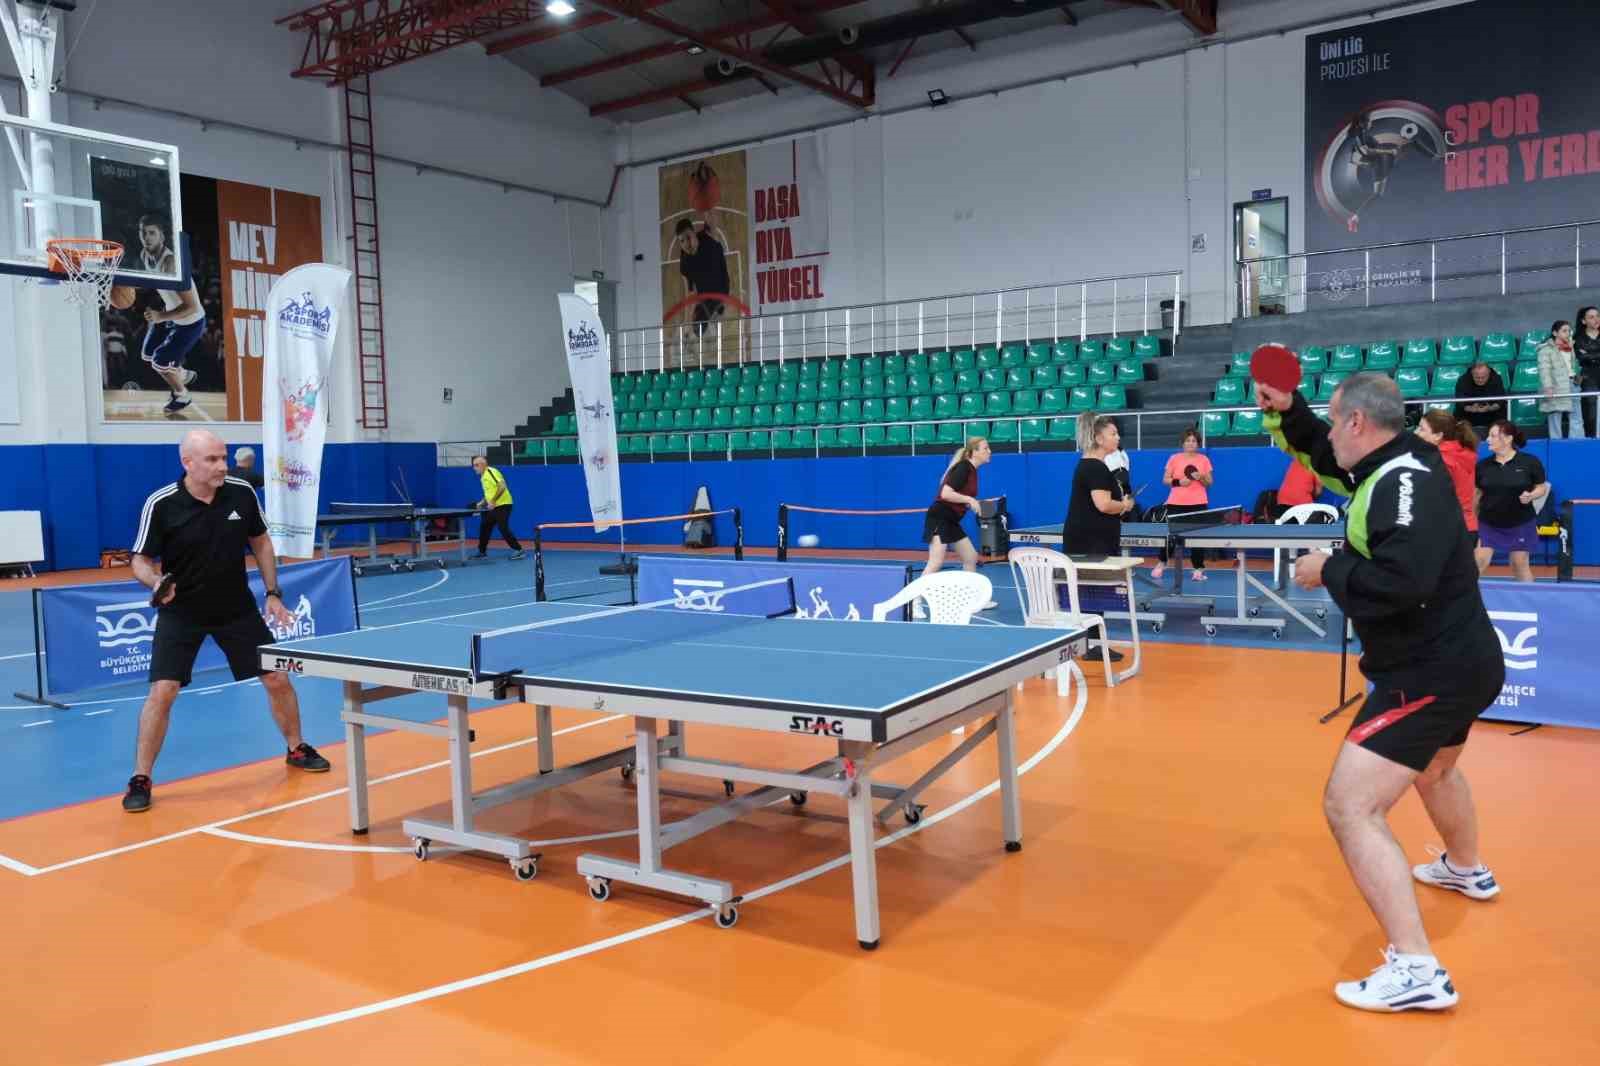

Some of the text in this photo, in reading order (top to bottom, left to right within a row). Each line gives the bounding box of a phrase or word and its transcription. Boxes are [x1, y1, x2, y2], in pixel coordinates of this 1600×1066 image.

[1445, 93, 1540, 146] SPOR
[1445, 129, 1600, 192] HER YERD
[754, 183, 800, 223] BAŞA
[229, 220, 277, 266] MEV
[756, 226, 793, 265] RIYA
[231, 267, 282, 311] KİN
[756, 265, 824, 305] YÜKSEL
[232, 315, 266, 358] YÜ
[275, 658, 304, 673] STAG
[790, 716, 844, 736] STAG
